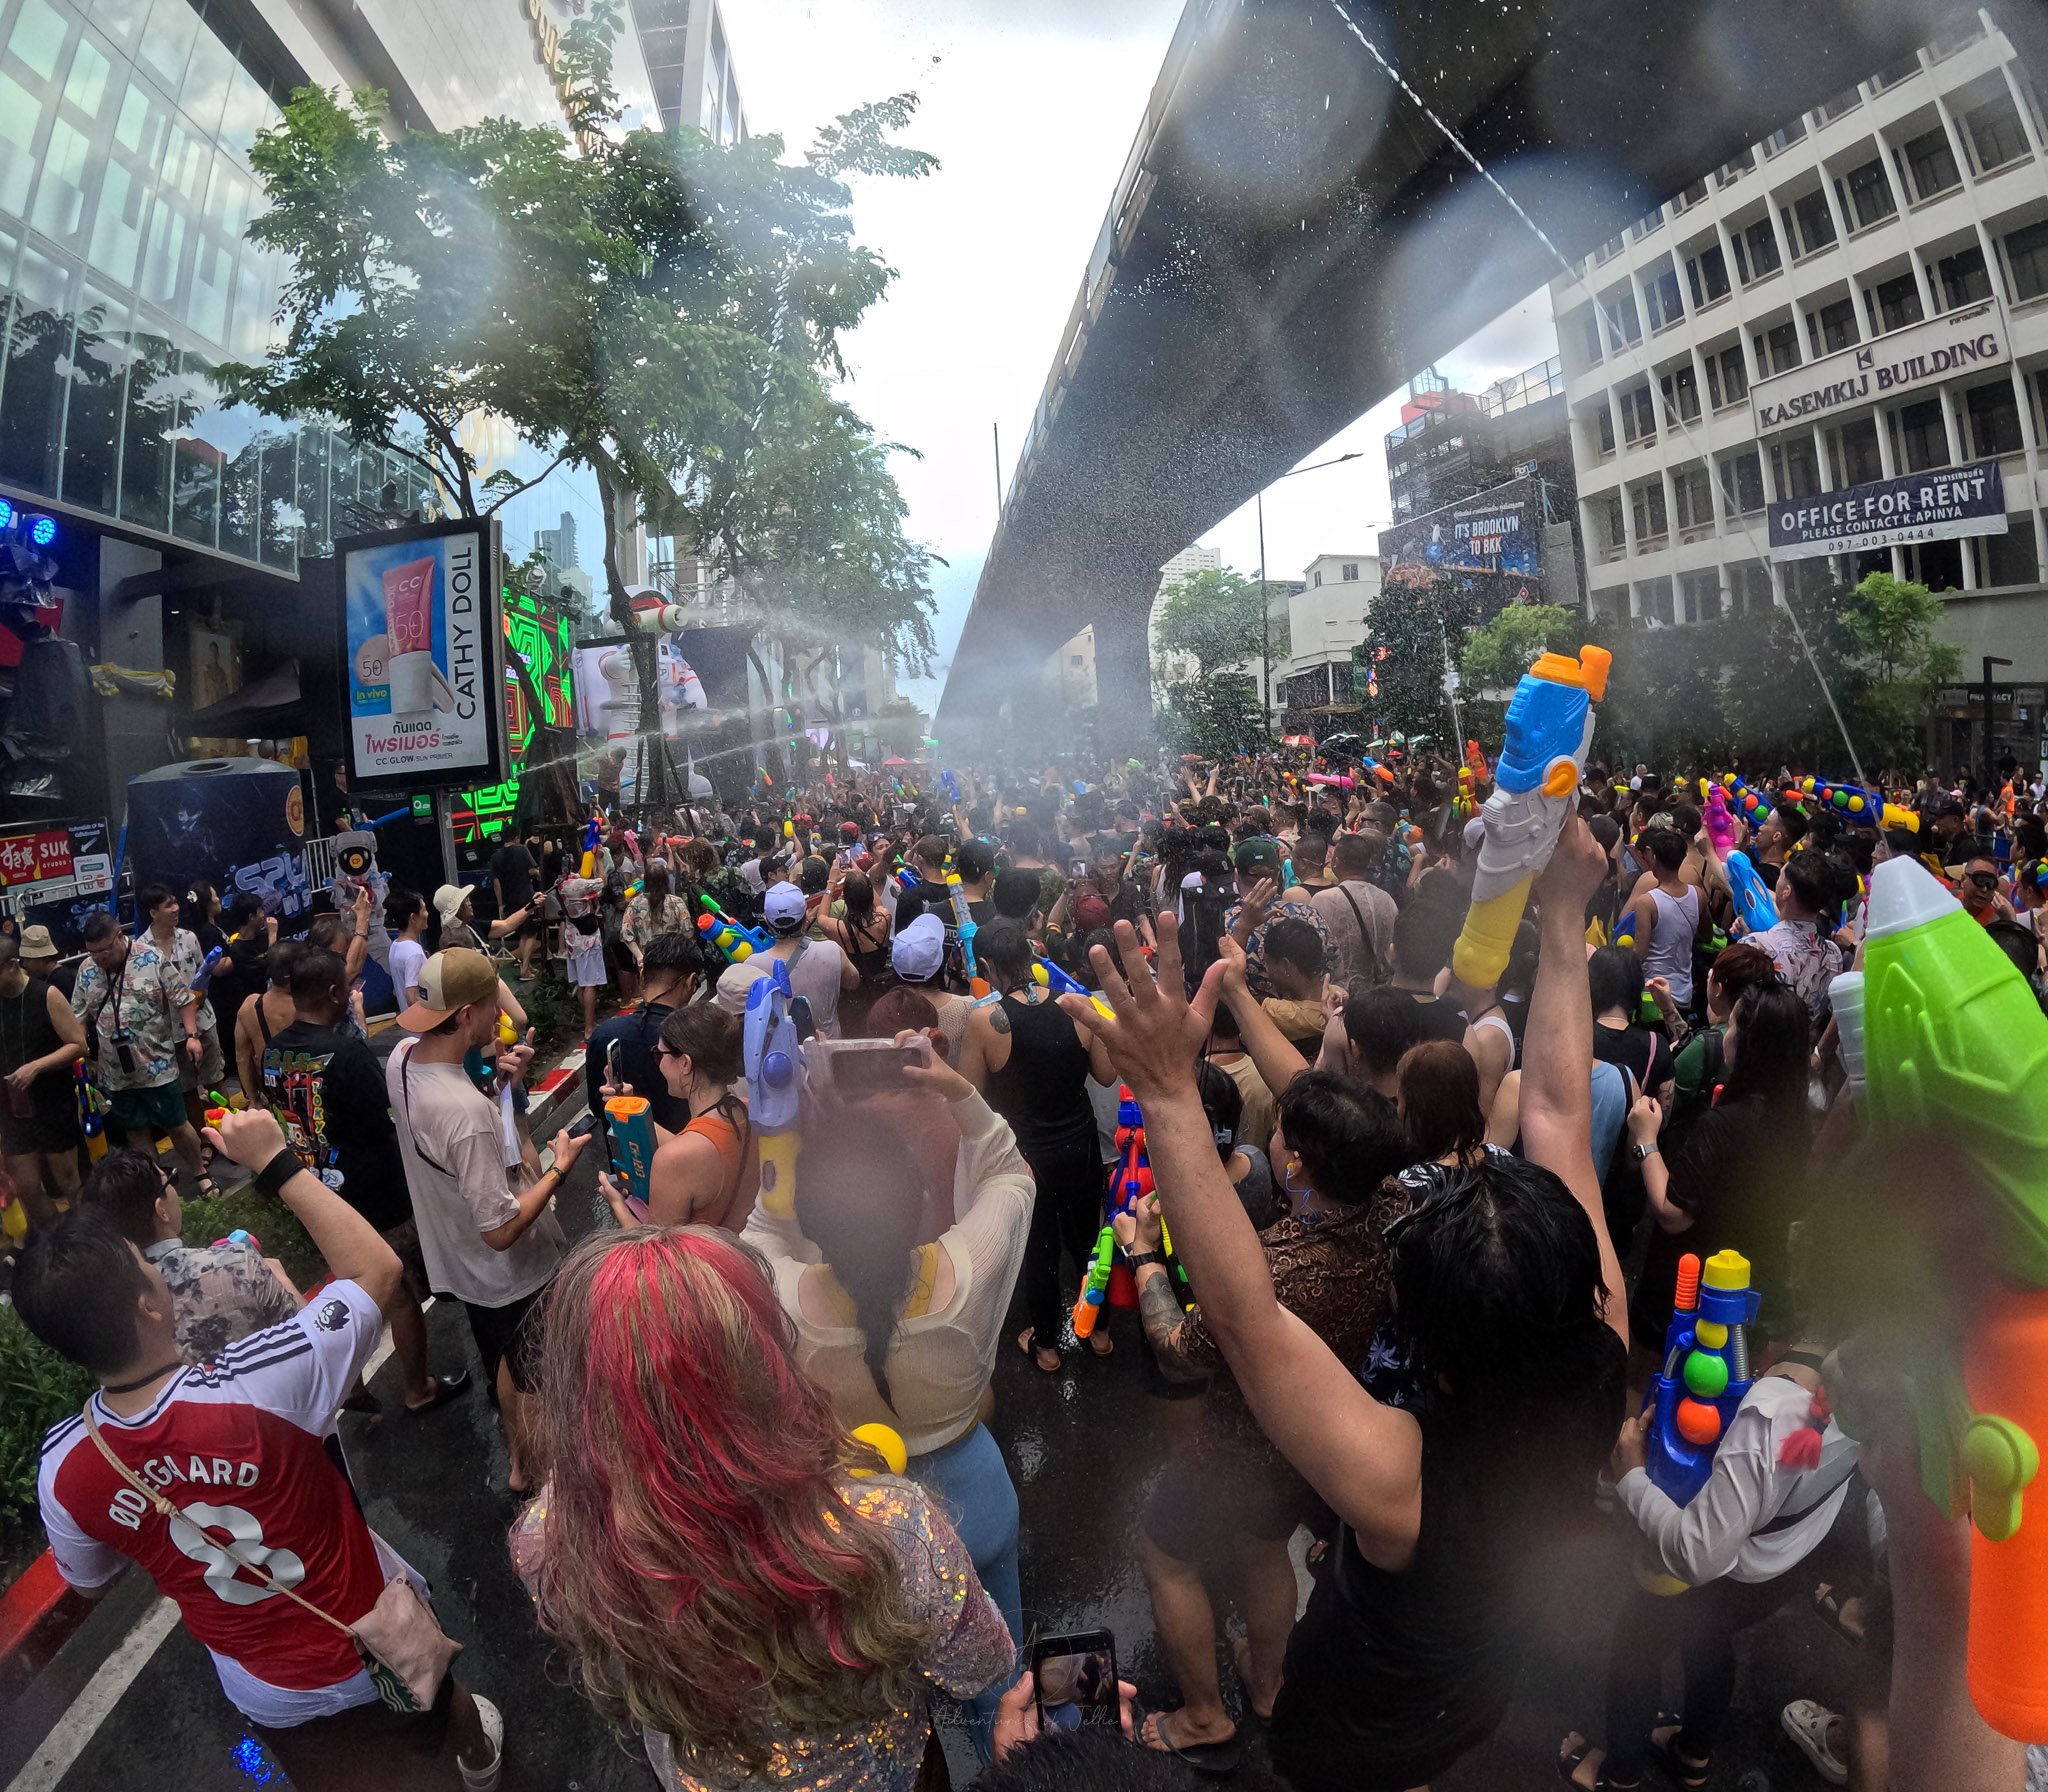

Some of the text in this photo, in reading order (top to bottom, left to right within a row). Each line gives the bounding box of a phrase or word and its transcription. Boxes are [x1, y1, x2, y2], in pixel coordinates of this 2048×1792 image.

[1759, 334, 1999, 428] KASEMKIJ BUILDING
[1781, 478, 1985, 531] OFFICE FOR RENT
[1455, 515, 1519, 539] IT'S BROOKLYN
[1802, 506, 1962, 540] PLEASE CONTACT K.APINYA
[1470, 536, 1502, 555] TO BKK
[1829, 528, 1934, 551] 097-003-0444
[399, 576, 420, 592] CC
[452, 547, 476, 719] CATHY DOLL
[366, 688, 388, 699] vivo
[1969, 693, 2012, 701] PHAACY
[392, 721, 432, 734] กันแดด
[365, 728, 441, 754] ไพรเมอร์
[390, 755, 414, 764] GLOW
[430, 752, 453, 760] PRIMER
[42, 860, 67, 868] GYUDON
[311, 1081, 328, 1144] TOKYO
[169, 1501, 305, 1606] 8
